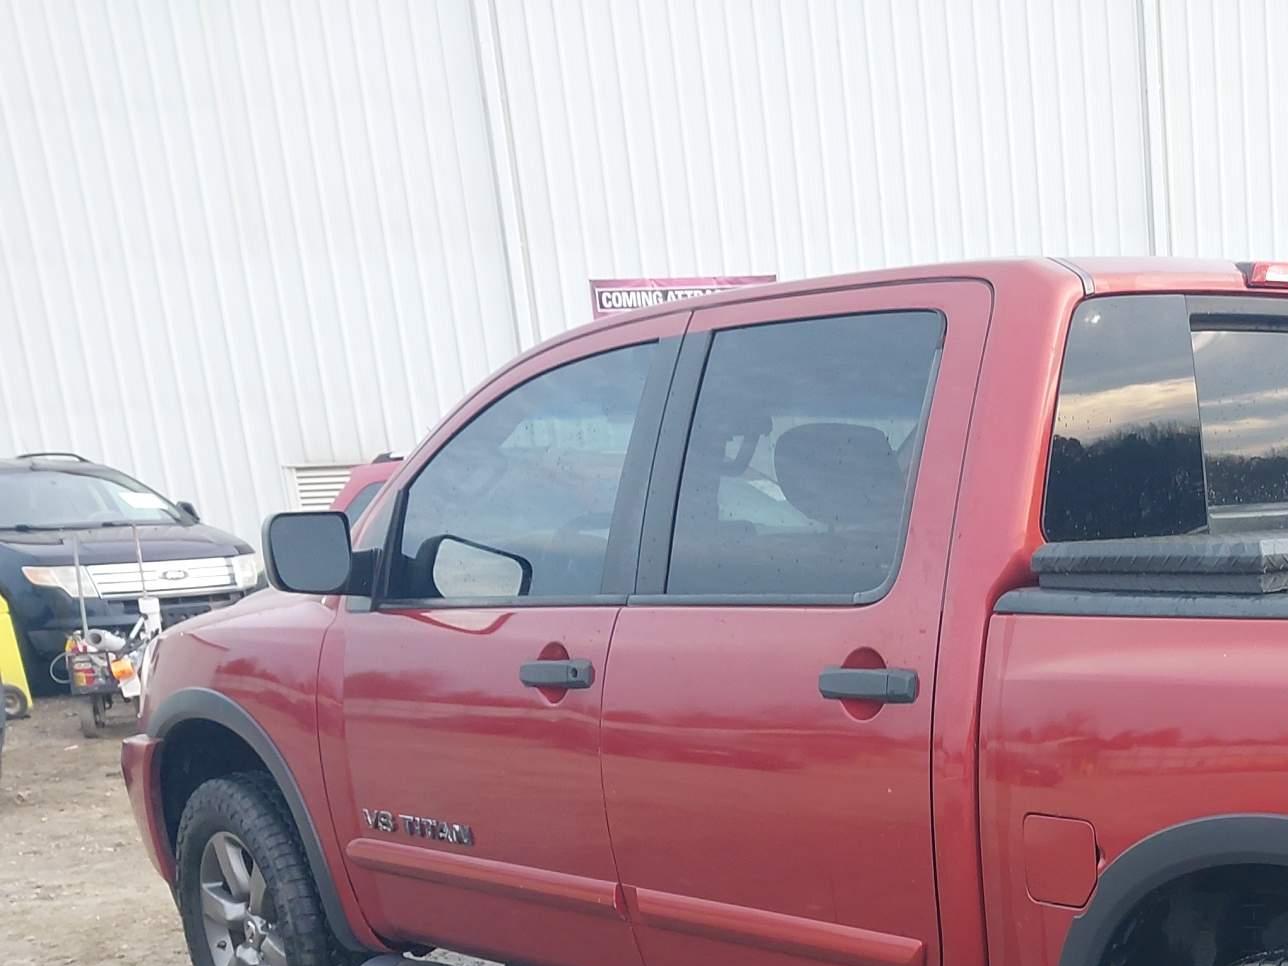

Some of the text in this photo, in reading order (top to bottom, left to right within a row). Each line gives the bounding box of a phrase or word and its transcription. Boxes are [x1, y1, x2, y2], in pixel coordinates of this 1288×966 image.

[601, 290, 663, 309] COMING
[362, 808, 474, 845] V8 TITAN
